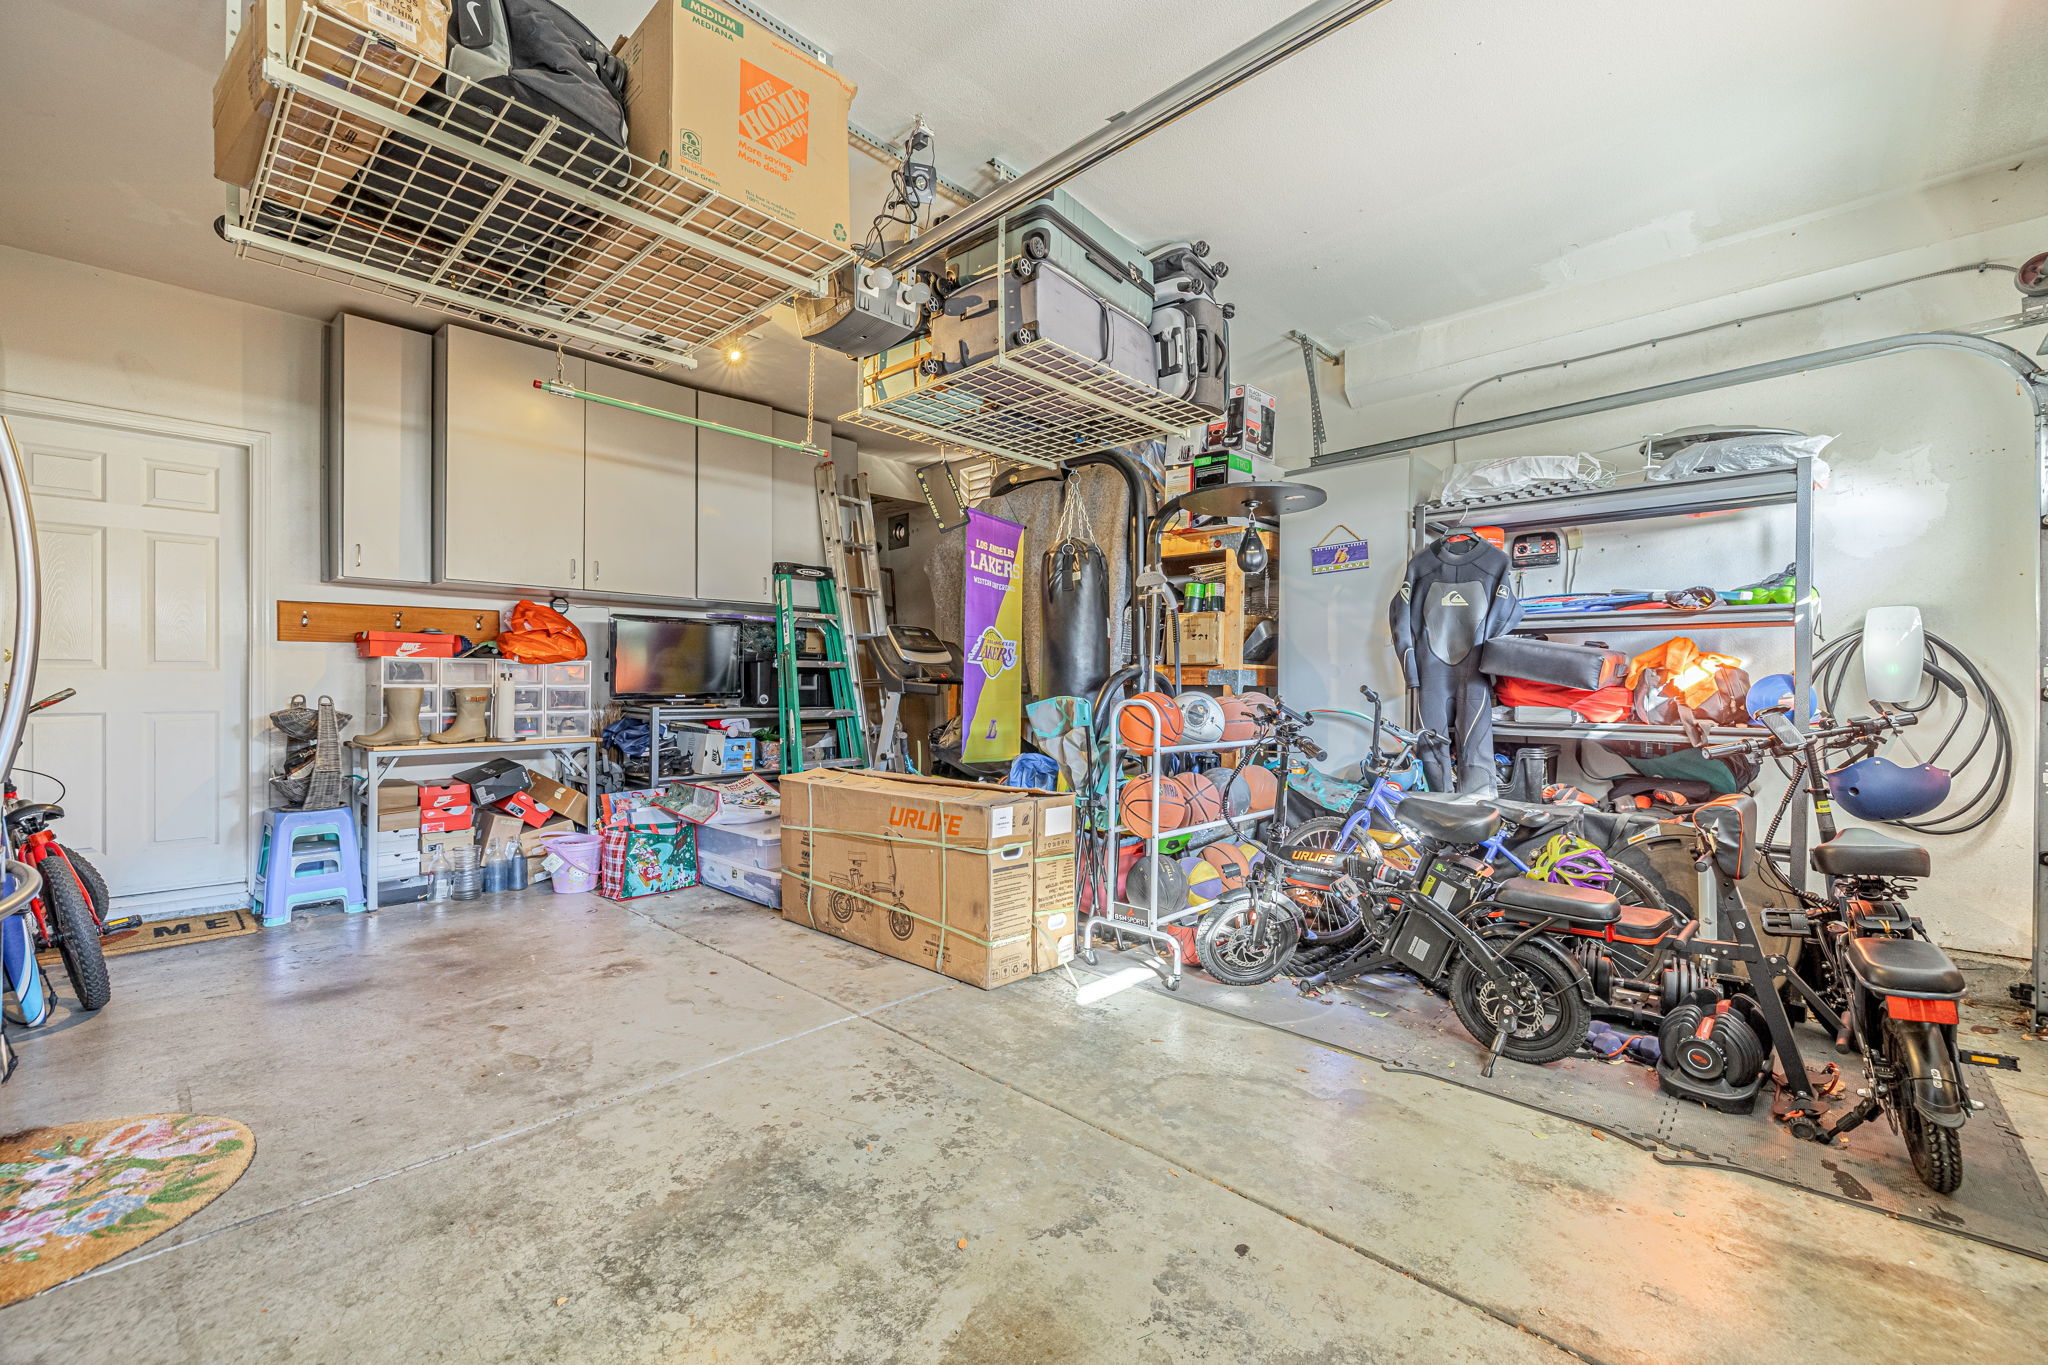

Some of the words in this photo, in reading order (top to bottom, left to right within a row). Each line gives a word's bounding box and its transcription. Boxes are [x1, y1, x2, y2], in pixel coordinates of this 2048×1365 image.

[391, 5, 421, 26] CHINA
[690, 0, 736, 31] MEDIUM
[692, 15, 734, 42] MEDIANA
[747, 80, 777, 103] THE
[739, 87, 809, 140] HOME
[767, 117, 809, 151] DEPOT
[682, 143, 700, 156] ECO
[738, 140, 762, 157] More
[764, 153, 794, 174] saving.
[680, 165, 699, 176] Think
[737, 151, 762, 168] More
[763, 163, 790, 182] doing.
[947, 474, 957, 490] SPORT
[922, 483, 929, 493] GO
[926, 493, 940, 519] LAKERS!
[976, 539, 988, 551] LOS
[989, 543, 1015, 558] ANGELES
[970, 550, 1021, 579] LAKERS
[973, 576, 991, 587] WESTERN
[400, 642, 422, 650] NIKE
[969, 637, 1015, 668] LAKERS
[985, 720, 997, 739] L
[889, 806, 964, 836] URLIFE
[1291, 850, 1336, 864] URLIFE
[1114, 913, 1127, 922] BSN
[1126, 916, 1149, 927] SPORTS
